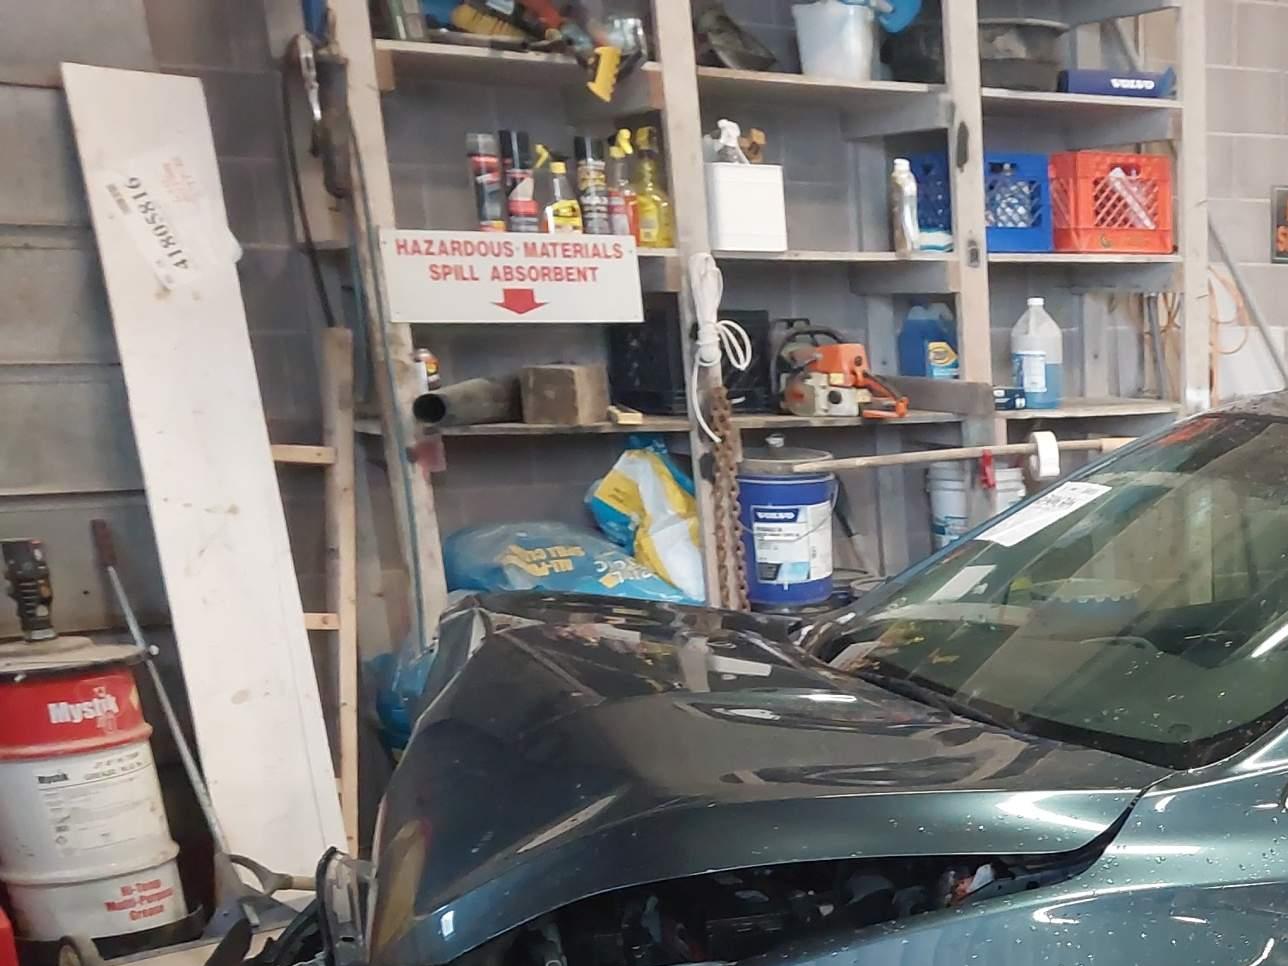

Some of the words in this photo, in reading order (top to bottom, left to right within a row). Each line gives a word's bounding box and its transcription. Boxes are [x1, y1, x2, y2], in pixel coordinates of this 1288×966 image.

[1110, 78, 1155, 90] VOLVO
[126, 177, 188, 269] 41805816
[396, 239, 515, 257] HAZARDOUS
[523, 241, 624, 259] MATERIALS
[429, 264, 480, 281] SPILL
[491, 266, 599, 283] ABSORBENT
[47, 695, 119, 724] Mystik
